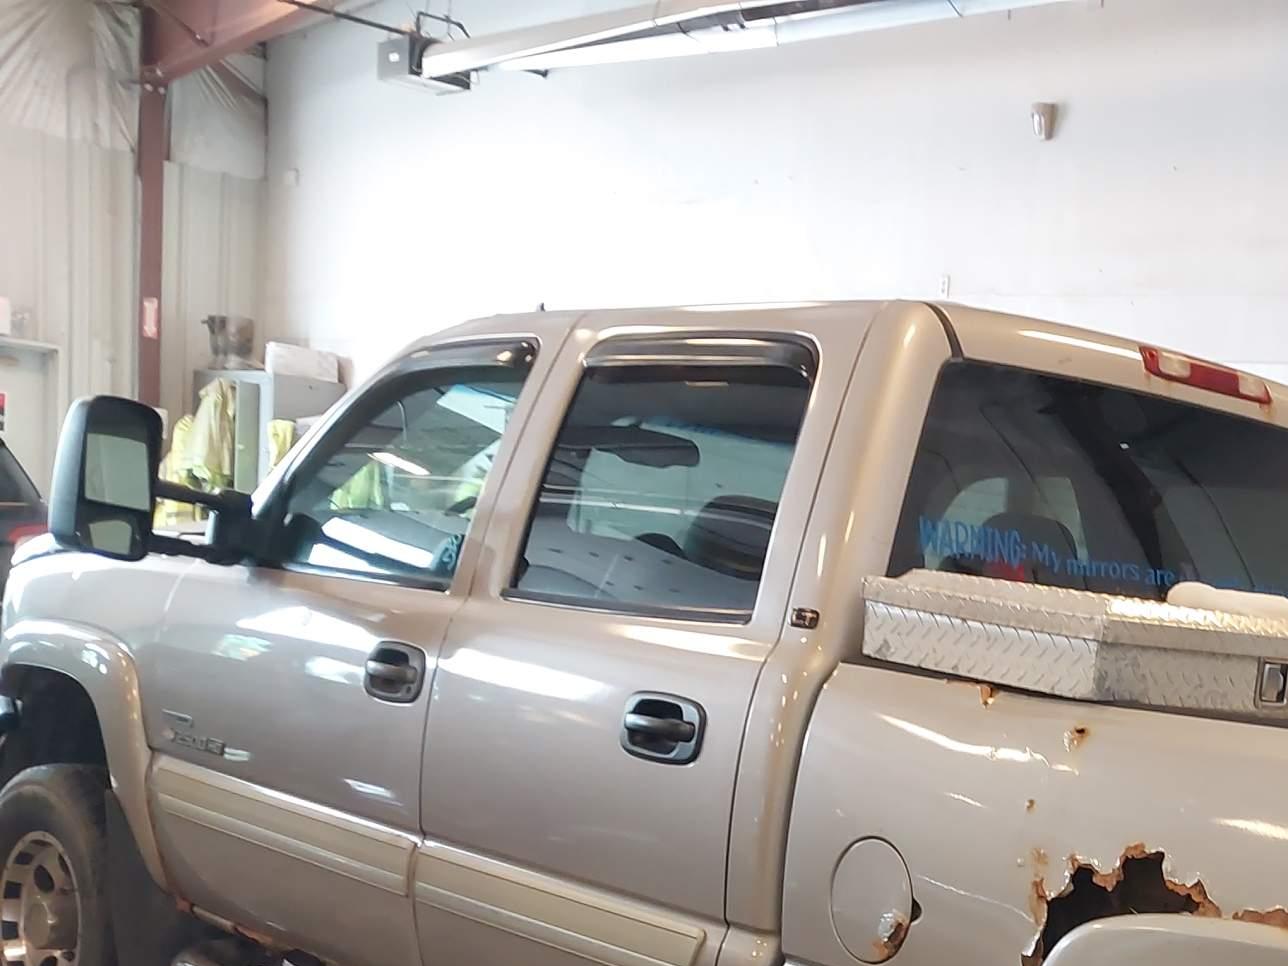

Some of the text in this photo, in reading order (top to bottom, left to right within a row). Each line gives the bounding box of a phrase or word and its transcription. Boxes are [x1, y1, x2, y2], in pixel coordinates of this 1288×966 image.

[1031, 541, 1059, 573] My
[1066, 557, 1140, 580] mirrors
[1145, 567, 1175, 586] are
